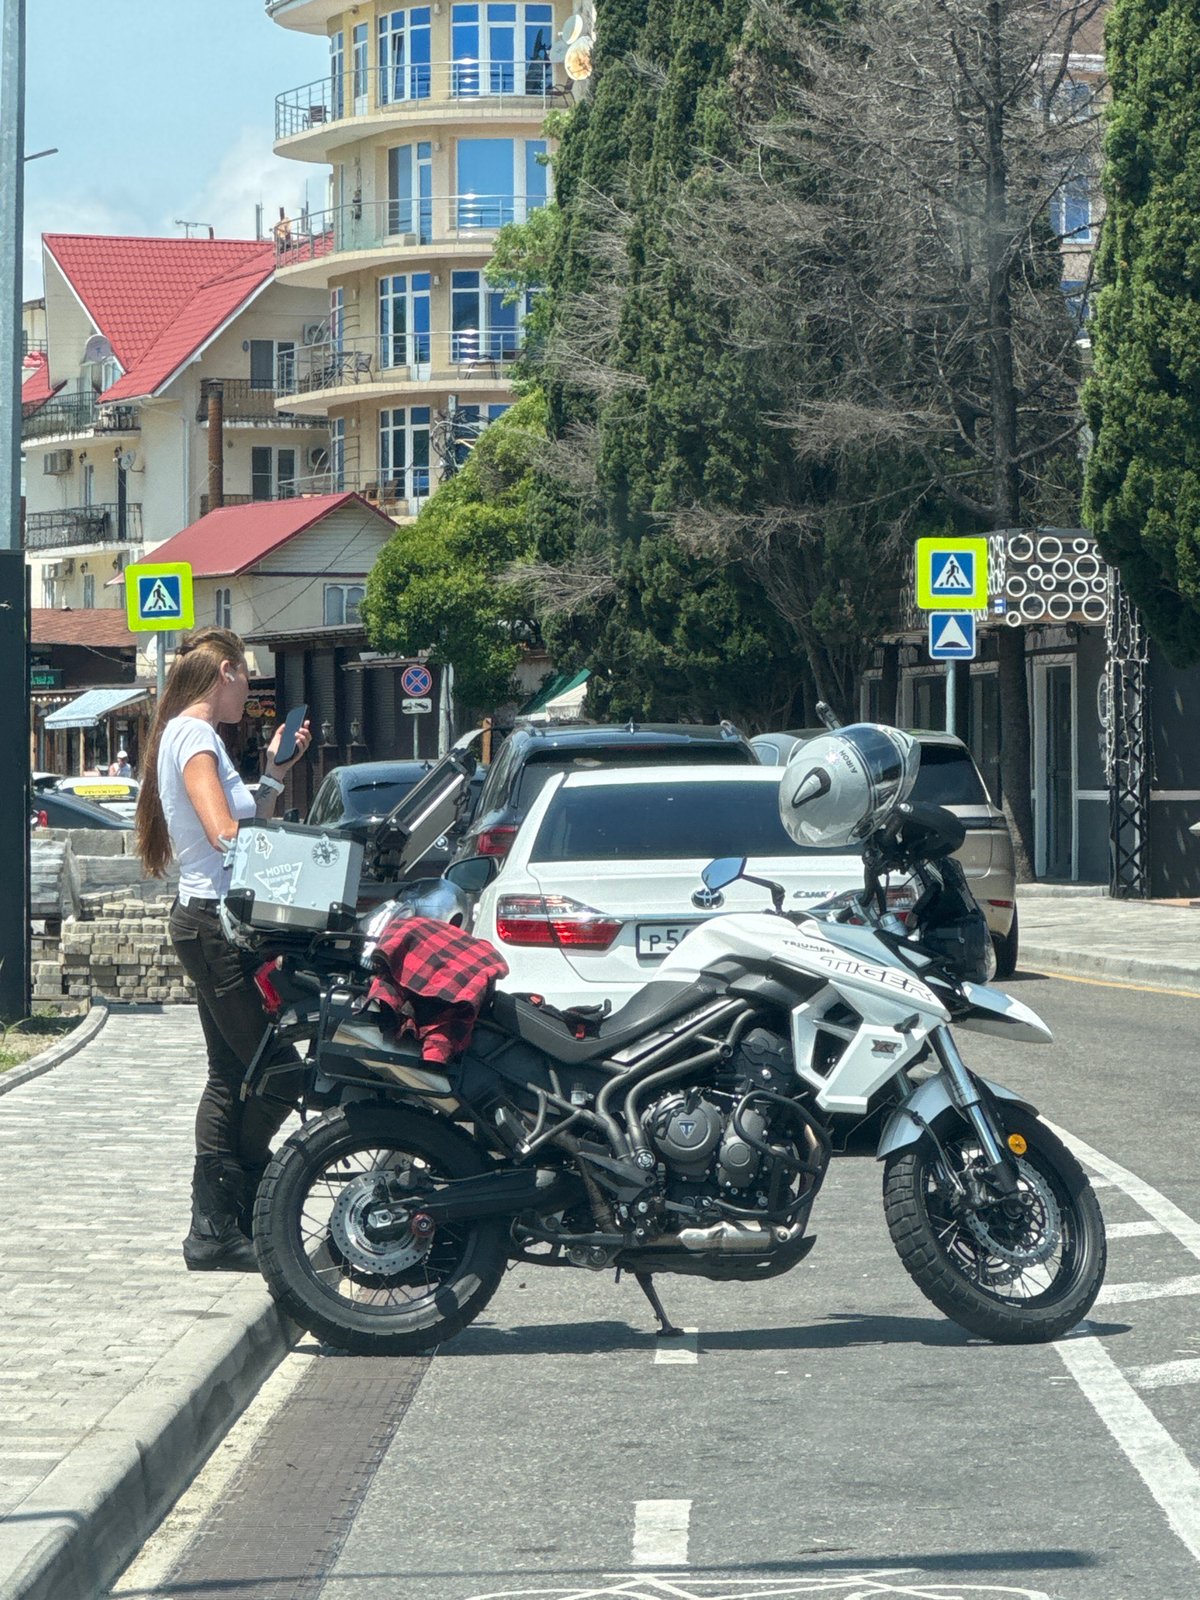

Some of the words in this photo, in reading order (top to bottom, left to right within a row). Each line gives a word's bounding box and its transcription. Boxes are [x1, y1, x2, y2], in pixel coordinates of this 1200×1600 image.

[839, 750, 858, 774] AIROH
[781, 939, 836, 955] TRIUMPH
[820, 956, 933, 1002] TIGER
